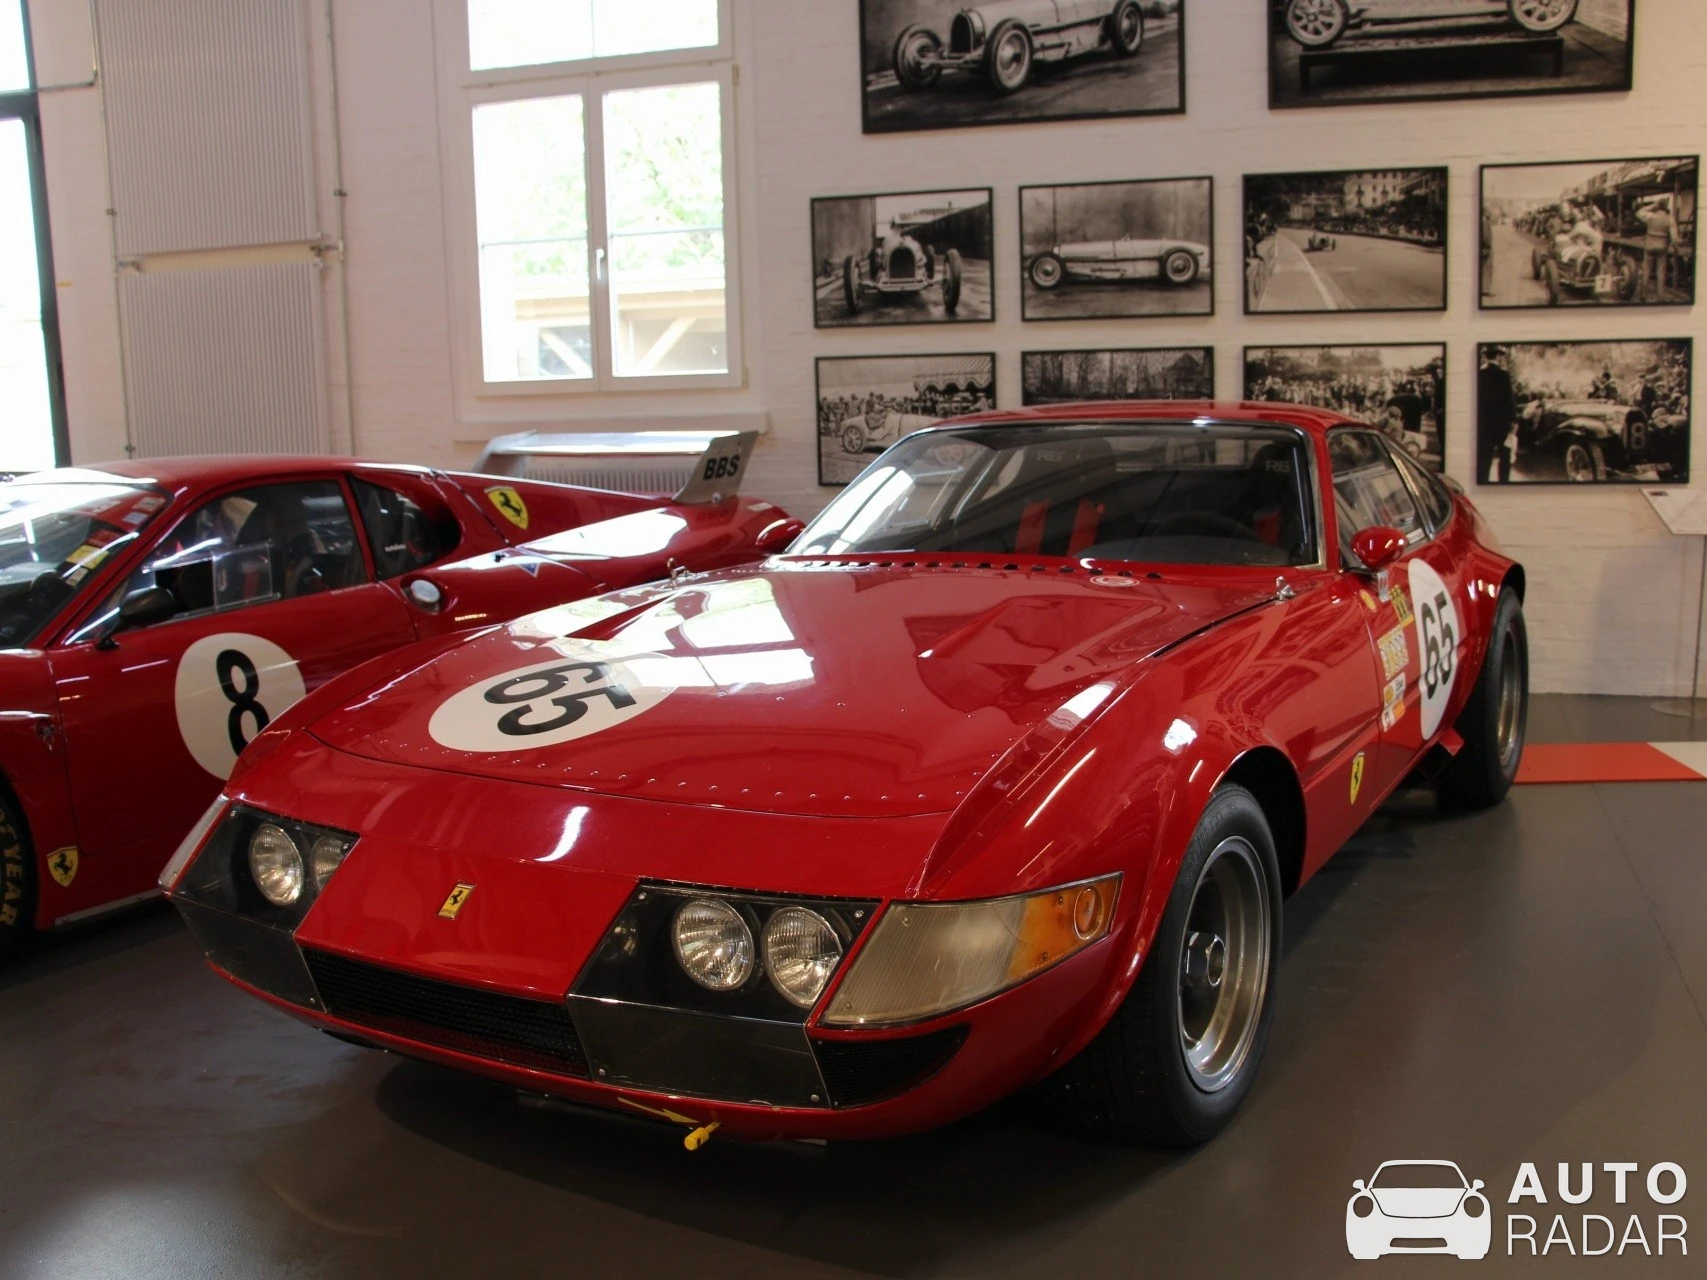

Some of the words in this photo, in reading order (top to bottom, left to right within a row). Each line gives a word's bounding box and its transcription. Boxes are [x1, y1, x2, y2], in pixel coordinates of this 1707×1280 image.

[703, 454, 740, 480] BBS
[1631, 422, 1647, 450] 8
[1421, 590, 1454, 700] 65
[216, 648, 271, 758] 8
[484, 661, 637, 736] 65
